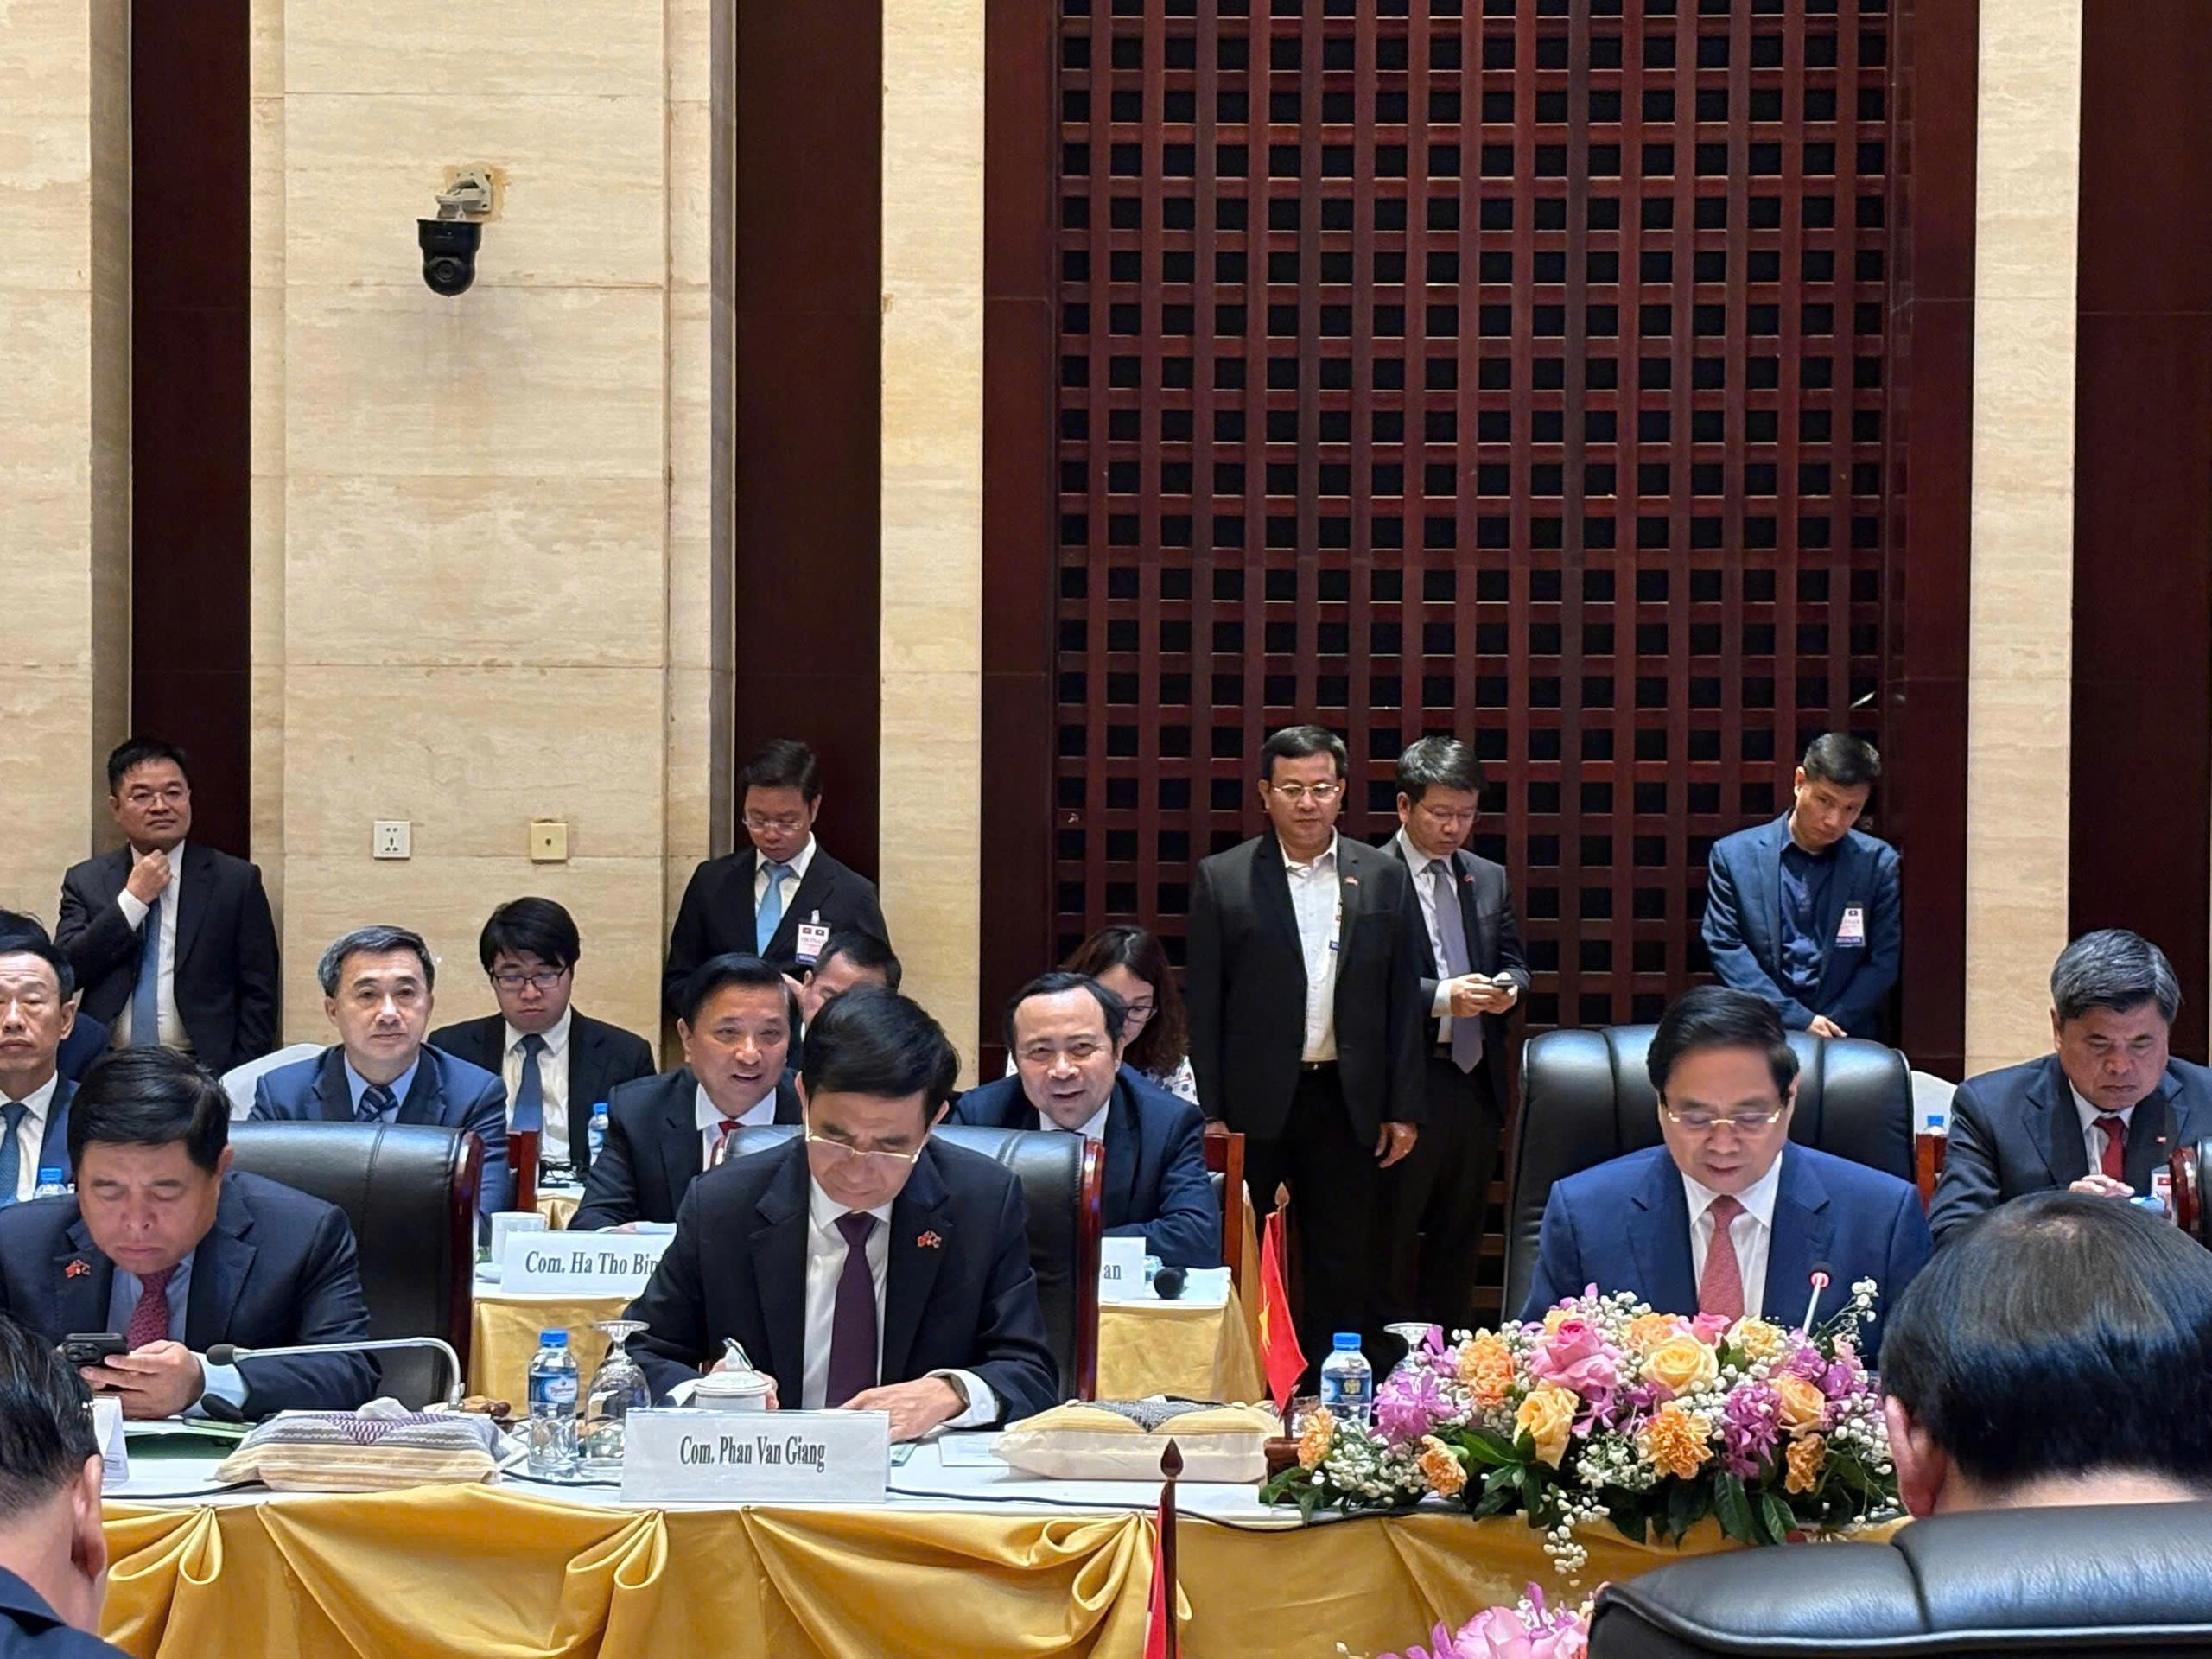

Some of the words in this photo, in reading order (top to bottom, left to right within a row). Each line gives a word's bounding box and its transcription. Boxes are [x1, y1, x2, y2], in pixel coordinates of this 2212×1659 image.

[525, 1251, 565, 1274] Com.
[569, 1252, 593, 1274] Ha
[598, 1253, 627, 1275] Tho
[681, 1435, 714, 1465] Com.
[719, 1436, 752, 1464] Phan
[756, 1436, 781, 1464] Van
[785, 1435, 825, 1472] Giang
